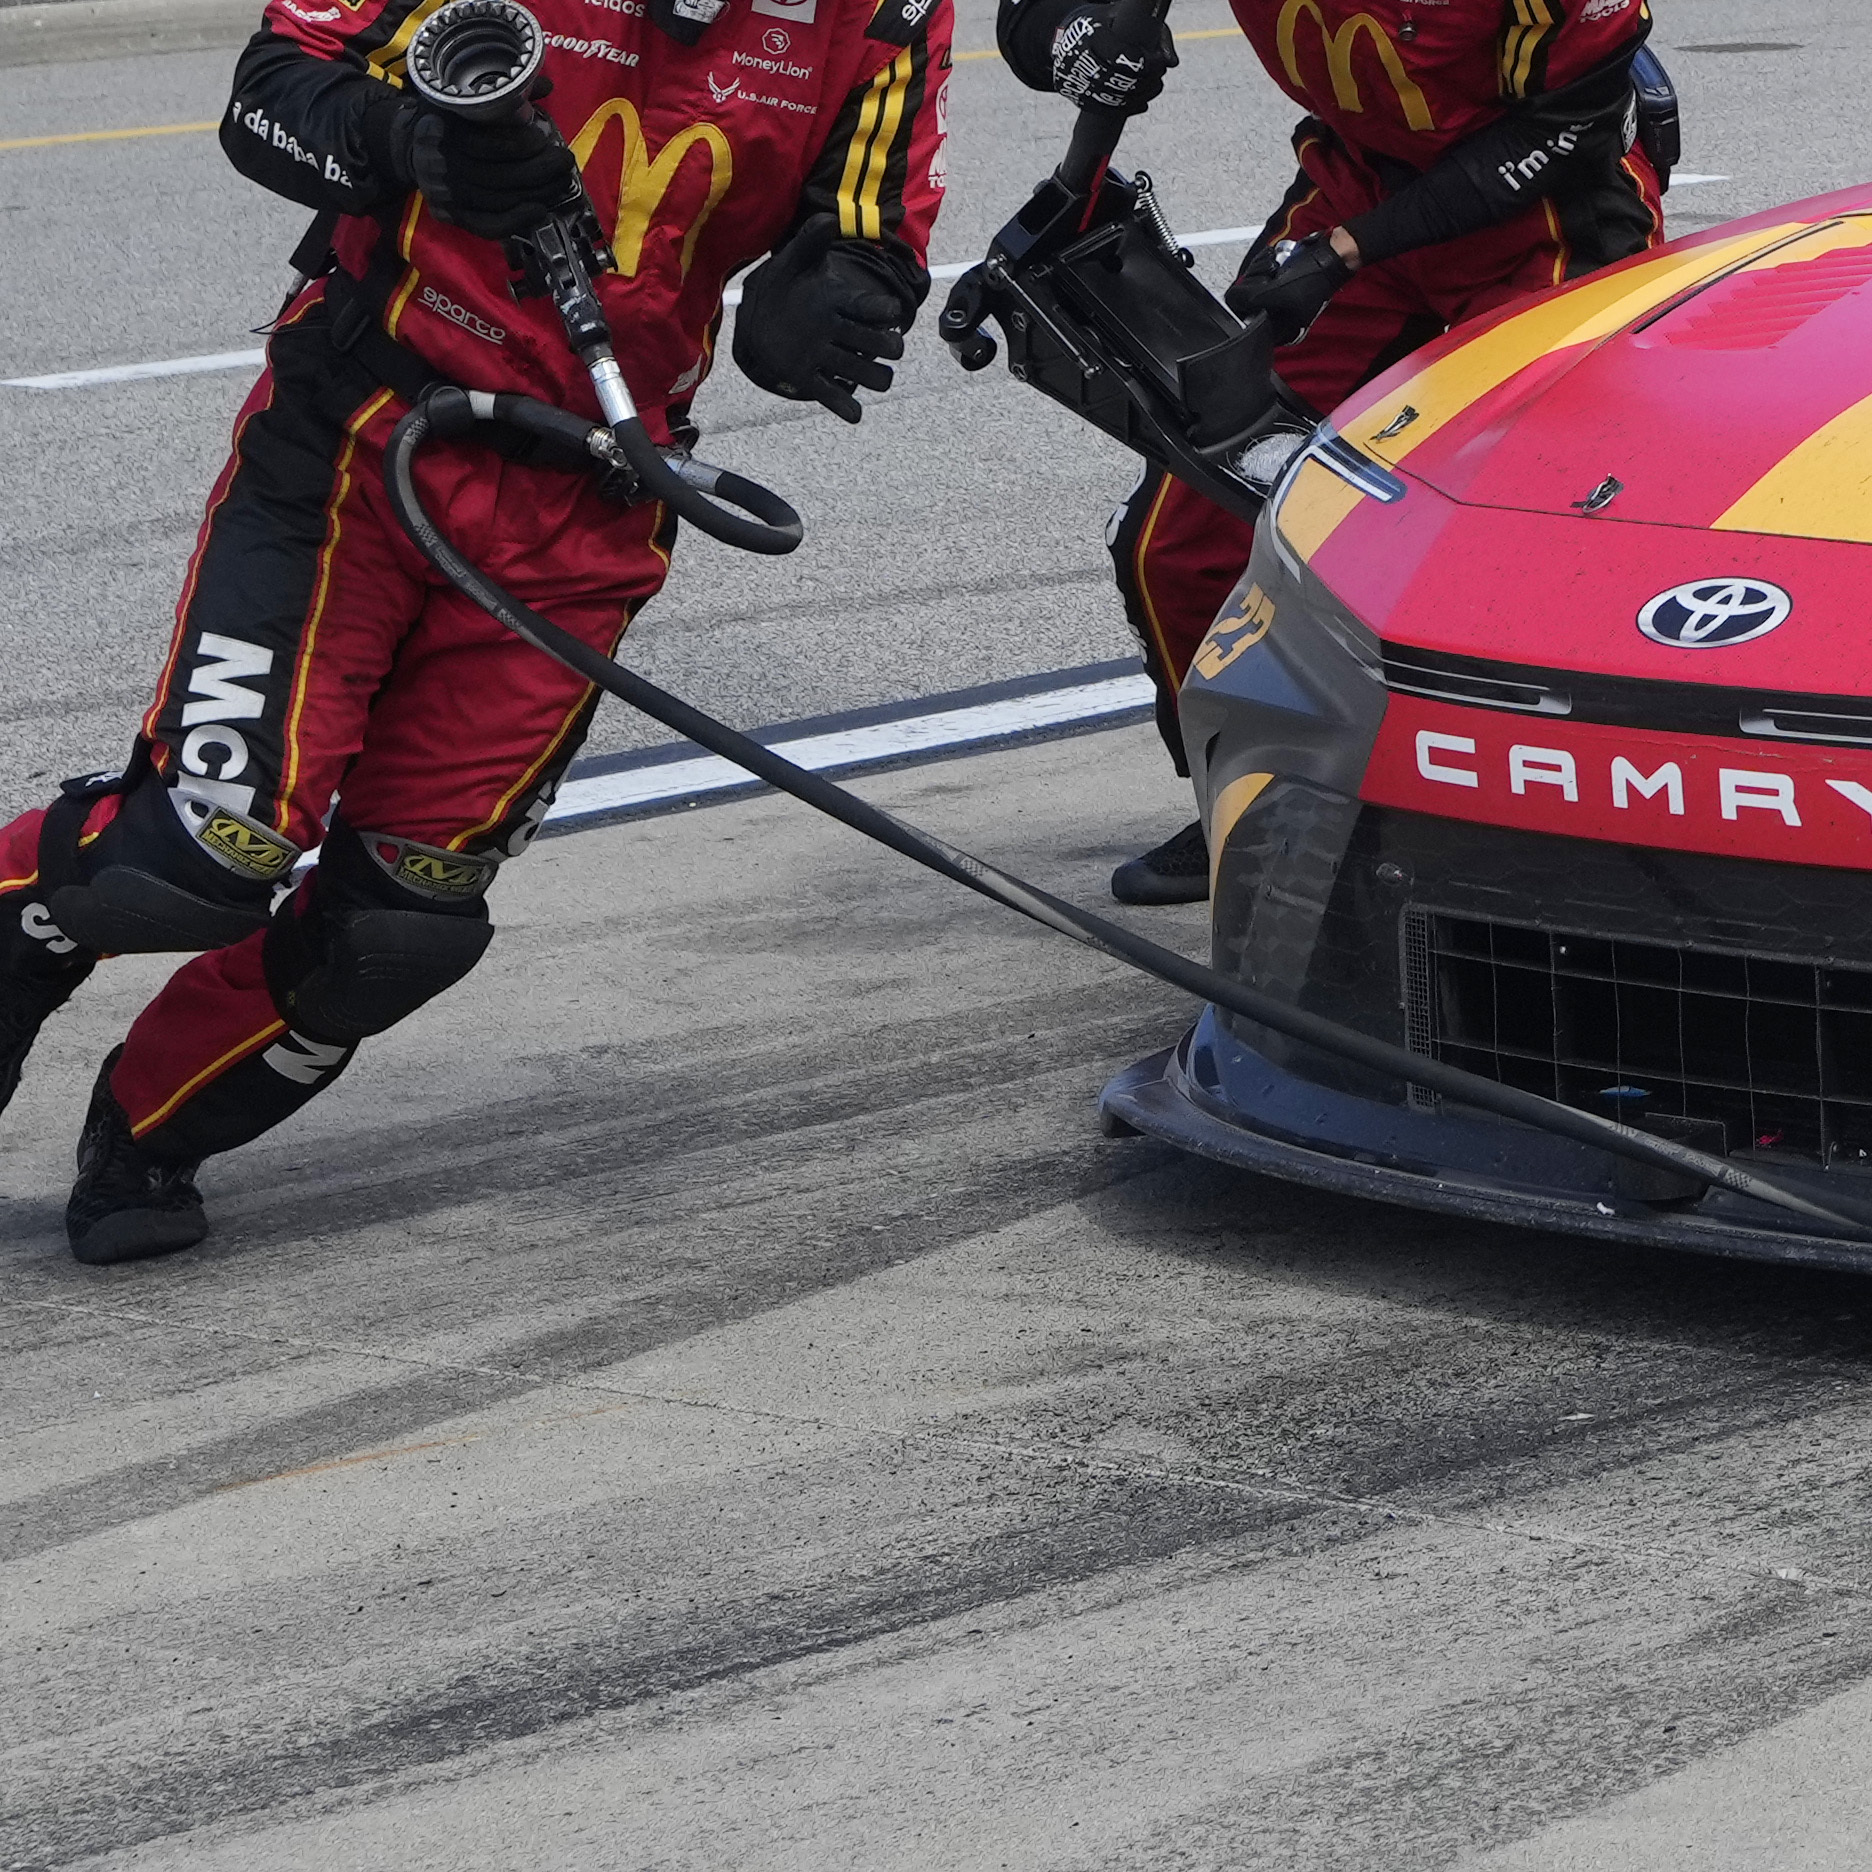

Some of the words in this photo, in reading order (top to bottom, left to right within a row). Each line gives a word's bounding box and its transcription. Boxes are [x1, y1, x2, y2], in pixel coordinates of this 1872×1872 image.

[541, 31, 640, 68] GOODYEAR
[732, 50, 814, 80] MoneyLion
[780, 100, 818, 116] FORCE
[1498, 146, 1550, 192] i'm
[420, 284, 507, 345] sparco
[1192, 581, 1276, 680] 23
